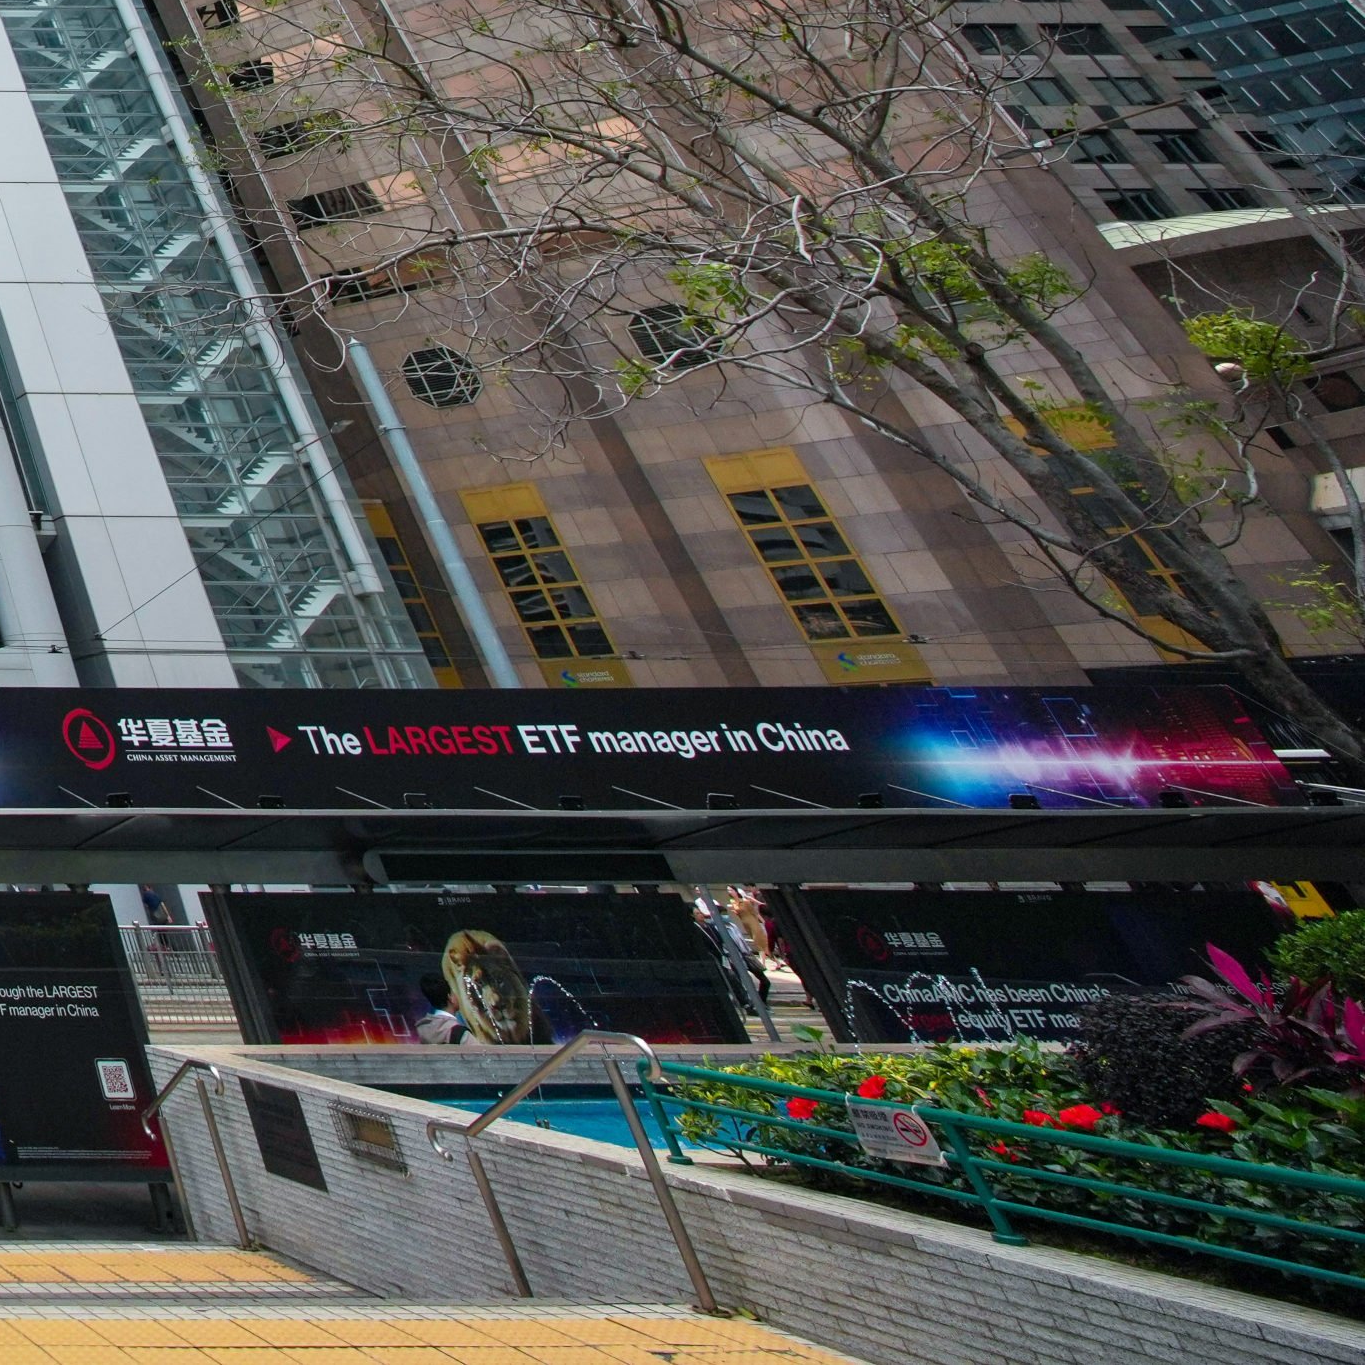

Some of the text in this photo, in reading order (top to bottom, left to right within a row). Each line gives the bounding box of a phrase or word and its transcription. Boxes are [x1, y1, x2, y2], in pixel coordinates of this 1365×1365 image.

[117, 718, 234, 747] 华夏基金
[297, 722, 851, 759] The LARGEST ETF manager in China
[127, 754, 238, 763] CHINA ASSET MANAGEMENT
[297, 932, 359, 949] 华夏基金
[883, 931, 947, 948] 华夏基金
[26, 985, 44, 998] the
[45, 985, 99, 998] LARGEST
[974, 985, 1004, 1003] has
[1004, 984, 1051, 1003] been
[1049, 984, 1111, 1004] China's
[9, 1006, 55, 1019] manager
[55, 1004, 68, 1017] in
[67, 1004, 100, 1017] China
[957, 1011, 1009, 1033] equity
[1008, 1009, 1047, 1028] ETF
